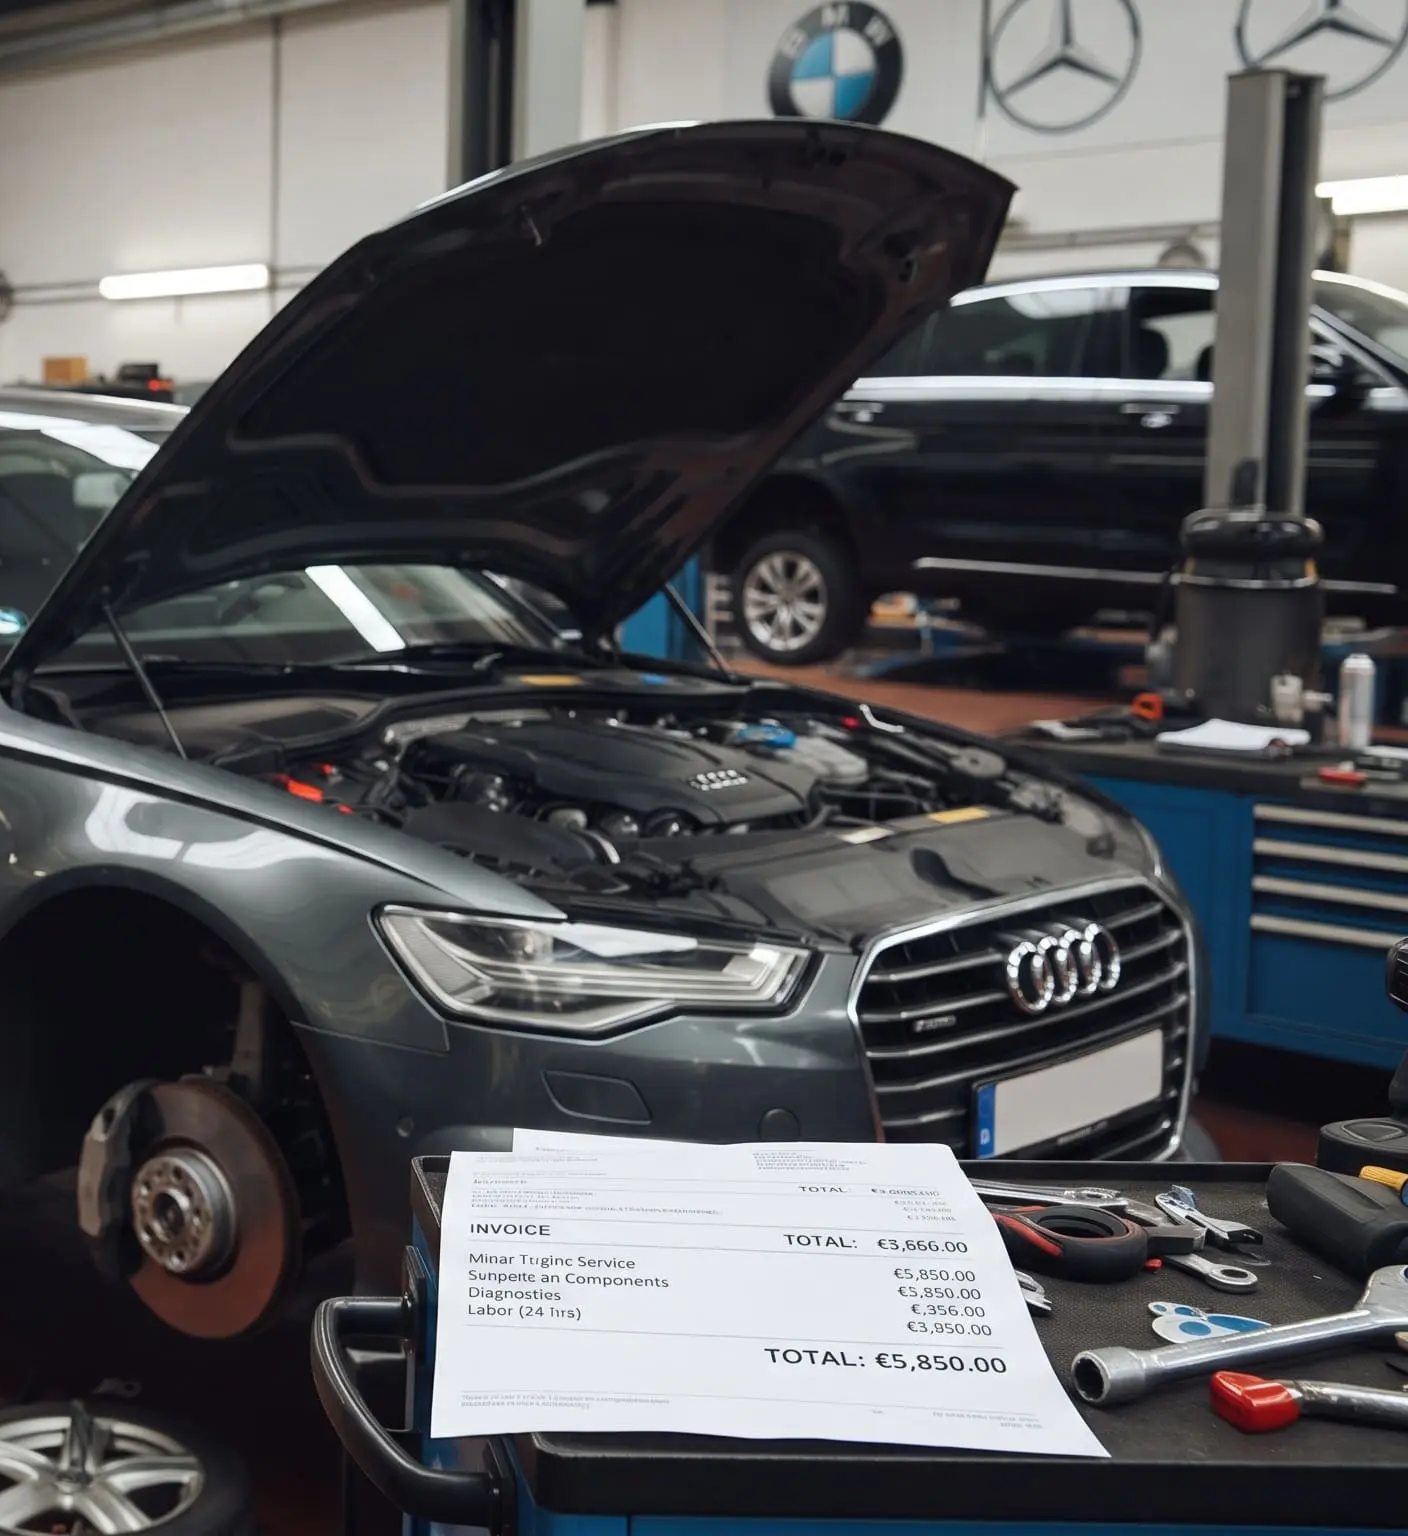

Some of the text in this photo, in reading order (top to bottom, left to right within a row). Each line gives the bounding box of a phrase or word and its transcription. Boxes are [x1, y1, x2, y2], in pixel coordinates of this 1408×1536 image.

[469, 1223, 551, 1236] INVOICE
[783, 1234, 858, 1249] TOTAL:
[469, 1253, 515, 1266] Minar
[577, 1256, 636, 1269] Service
[541, 1274, 561, 1284] an
[565, 1273, 670, 1288] Components
[893, 1268, 976, 1282] €5,850.00
[897, 1286, 981, 1300] €5,850.00
[468, 1304, 514, 1317] Labor
[519, 1305, 545, 1319] (24
[764, 1348, 1007, 1374] TOTAL: €5,850.00
